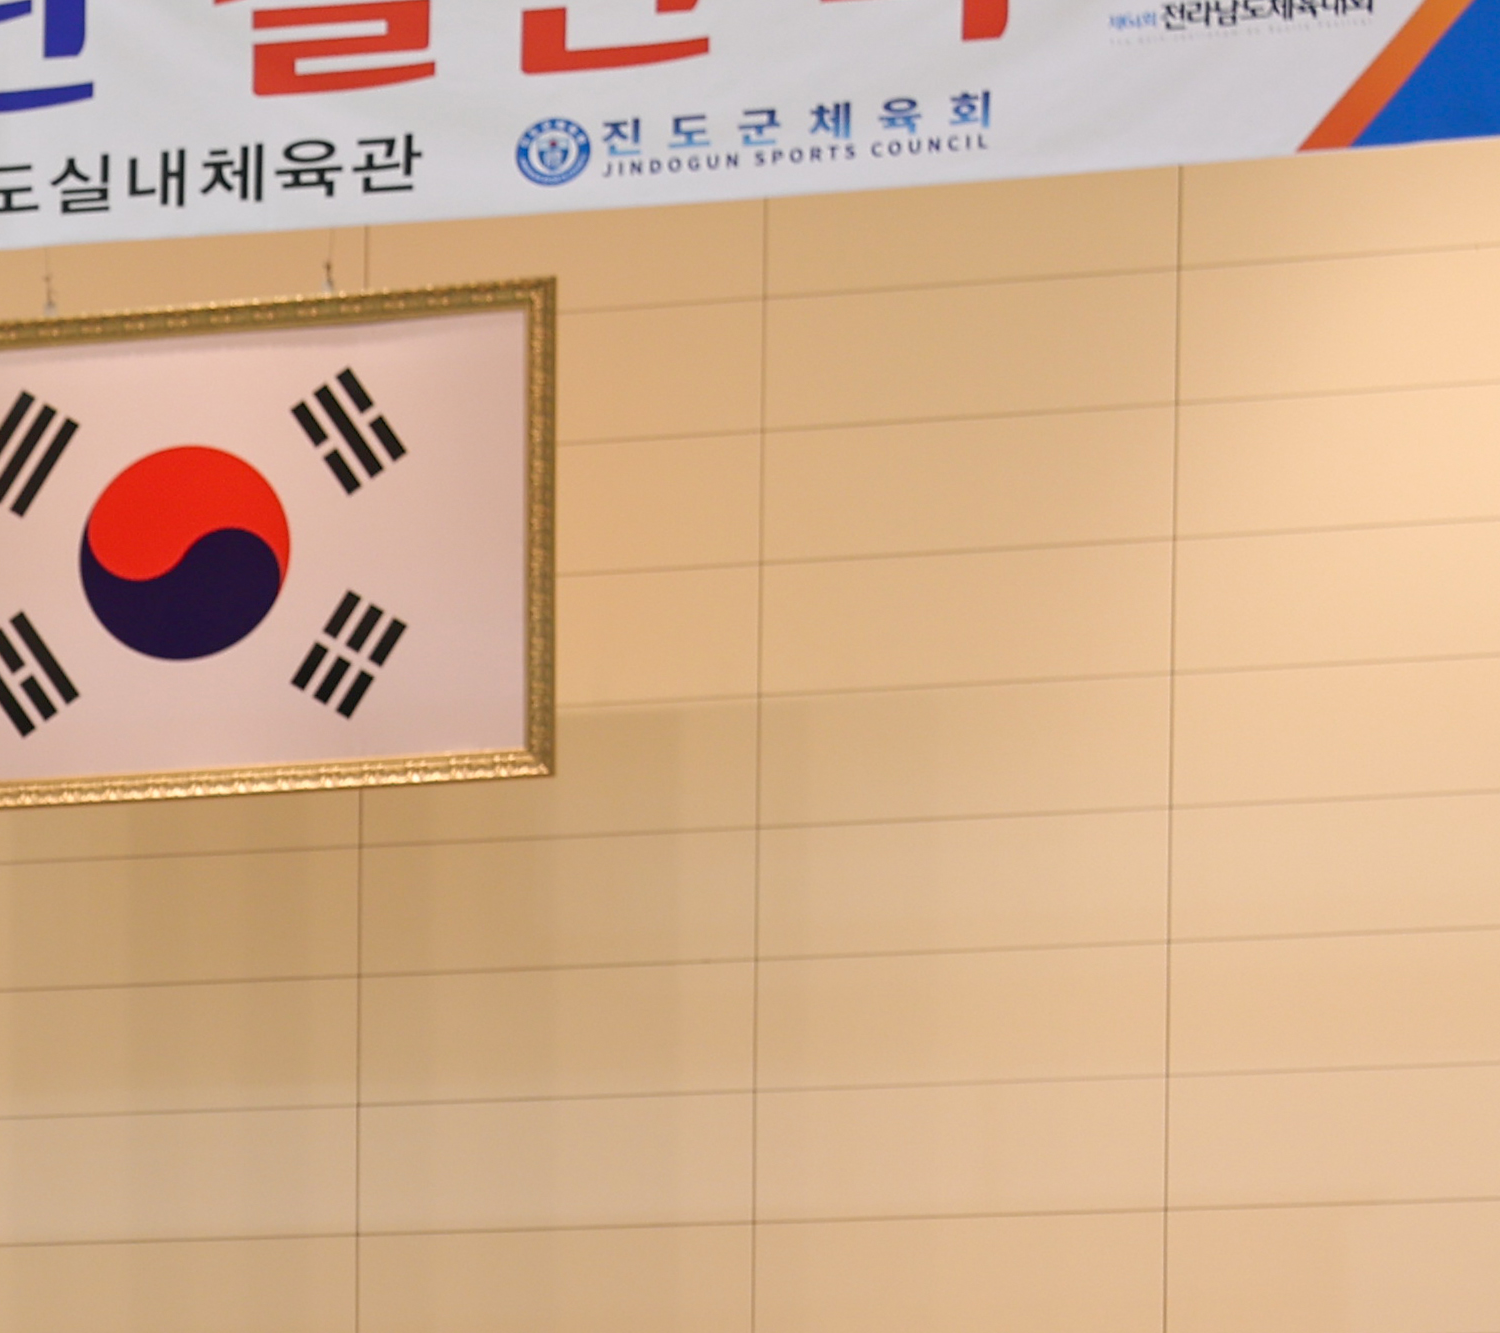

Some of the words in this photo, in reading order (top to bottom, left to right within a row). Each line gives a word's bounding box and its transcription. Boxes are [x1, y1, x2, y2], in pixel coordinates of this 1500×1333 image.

[601, 152, 740, 178] JINDOGUN
[754, 142, 857, 167] SPORTS
[870, 133, 990, 158] COUNCIL
